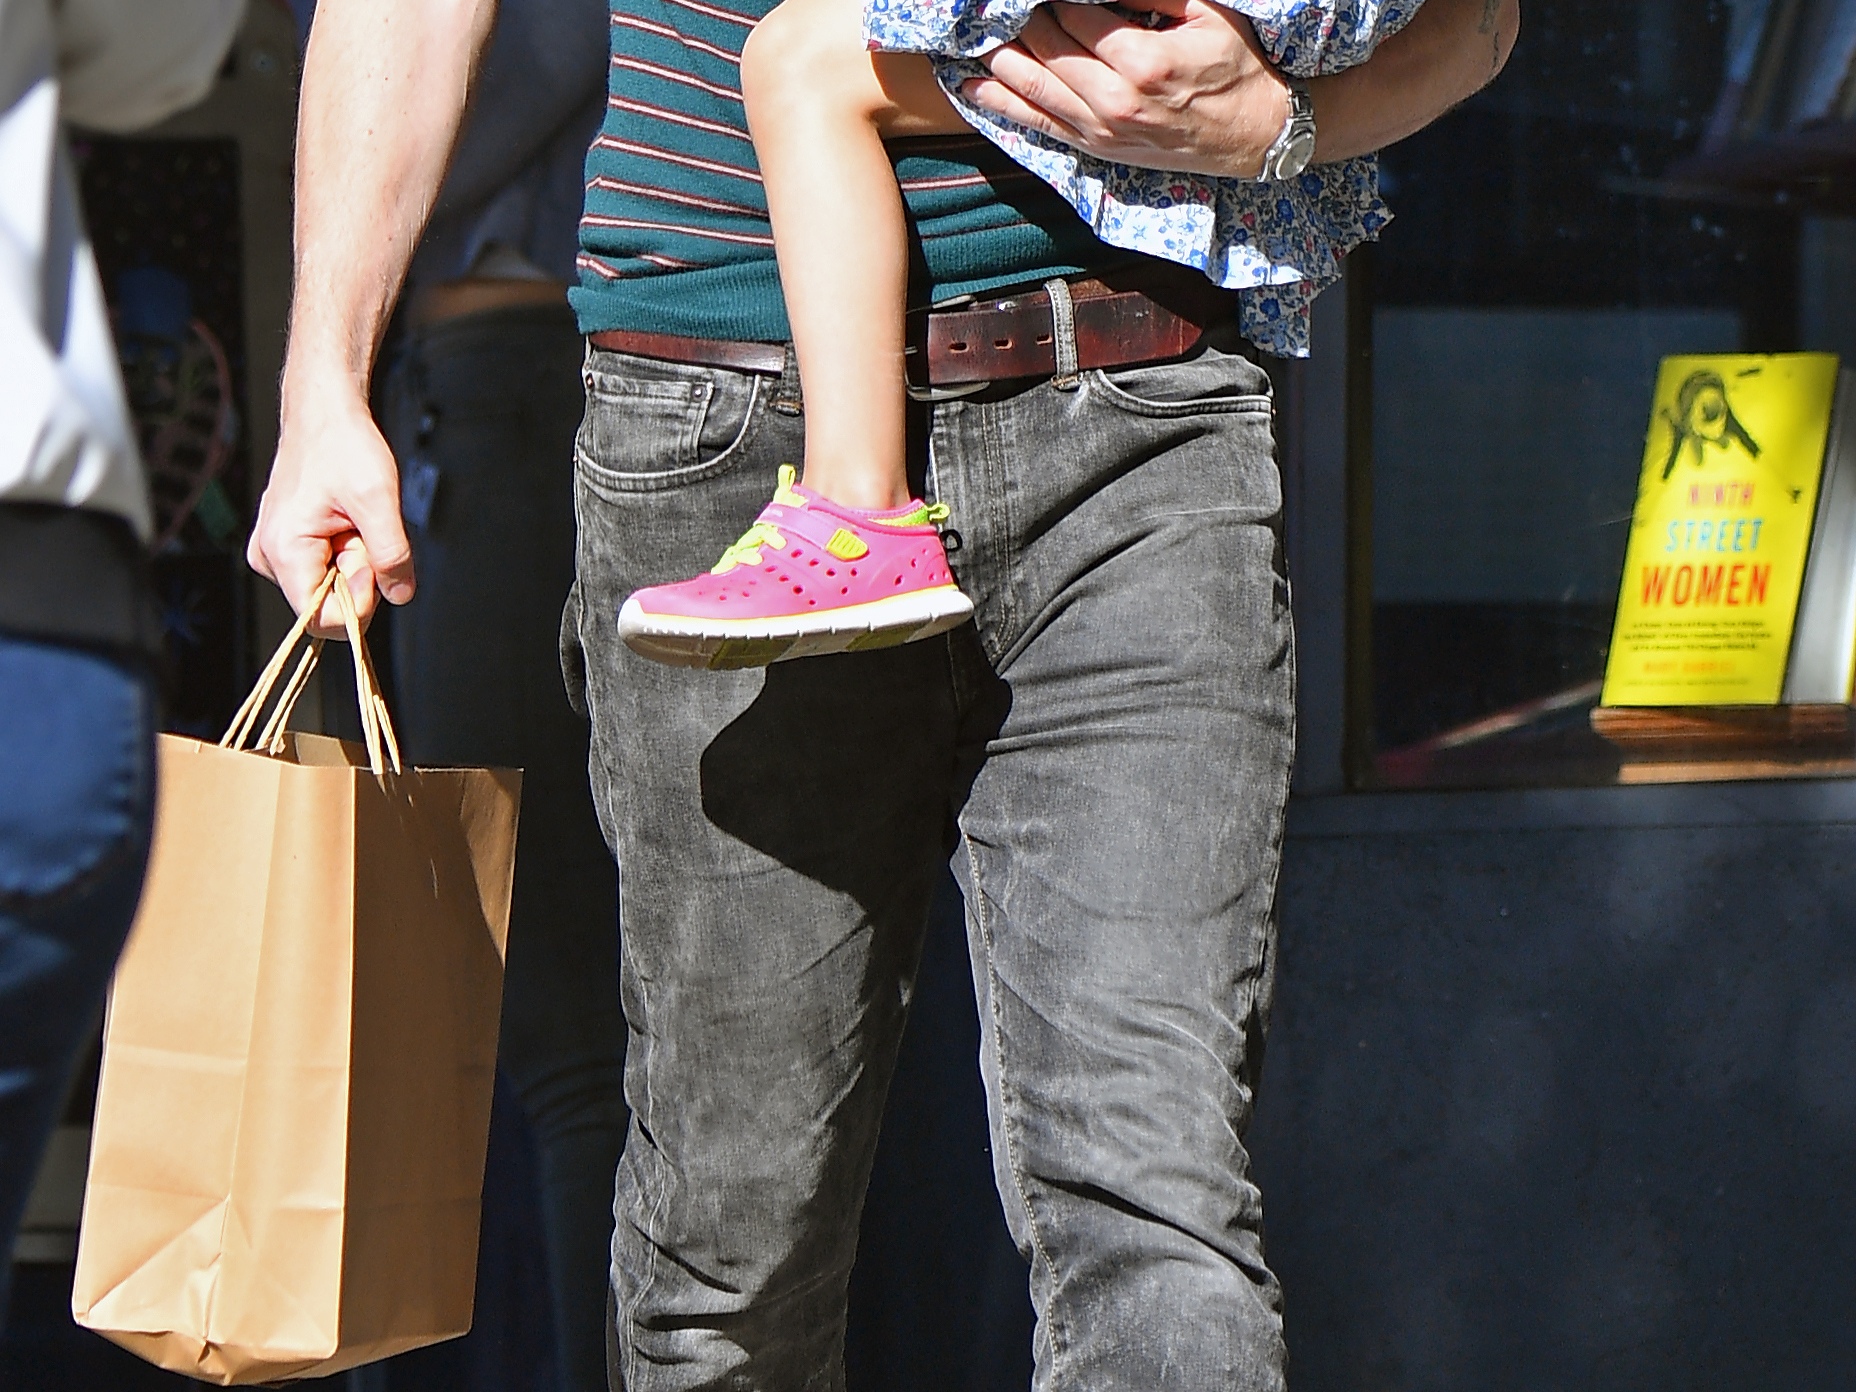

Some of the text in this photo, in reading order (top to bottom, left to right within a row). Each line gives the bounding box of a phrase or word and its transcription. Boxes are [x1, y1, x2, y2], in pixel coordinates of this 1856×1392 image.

[1689, 483, 1756, 506] NINTH
[1666, 519, 1763, 551] STREET
[1642, 564, 1771, 606] WOMEN
